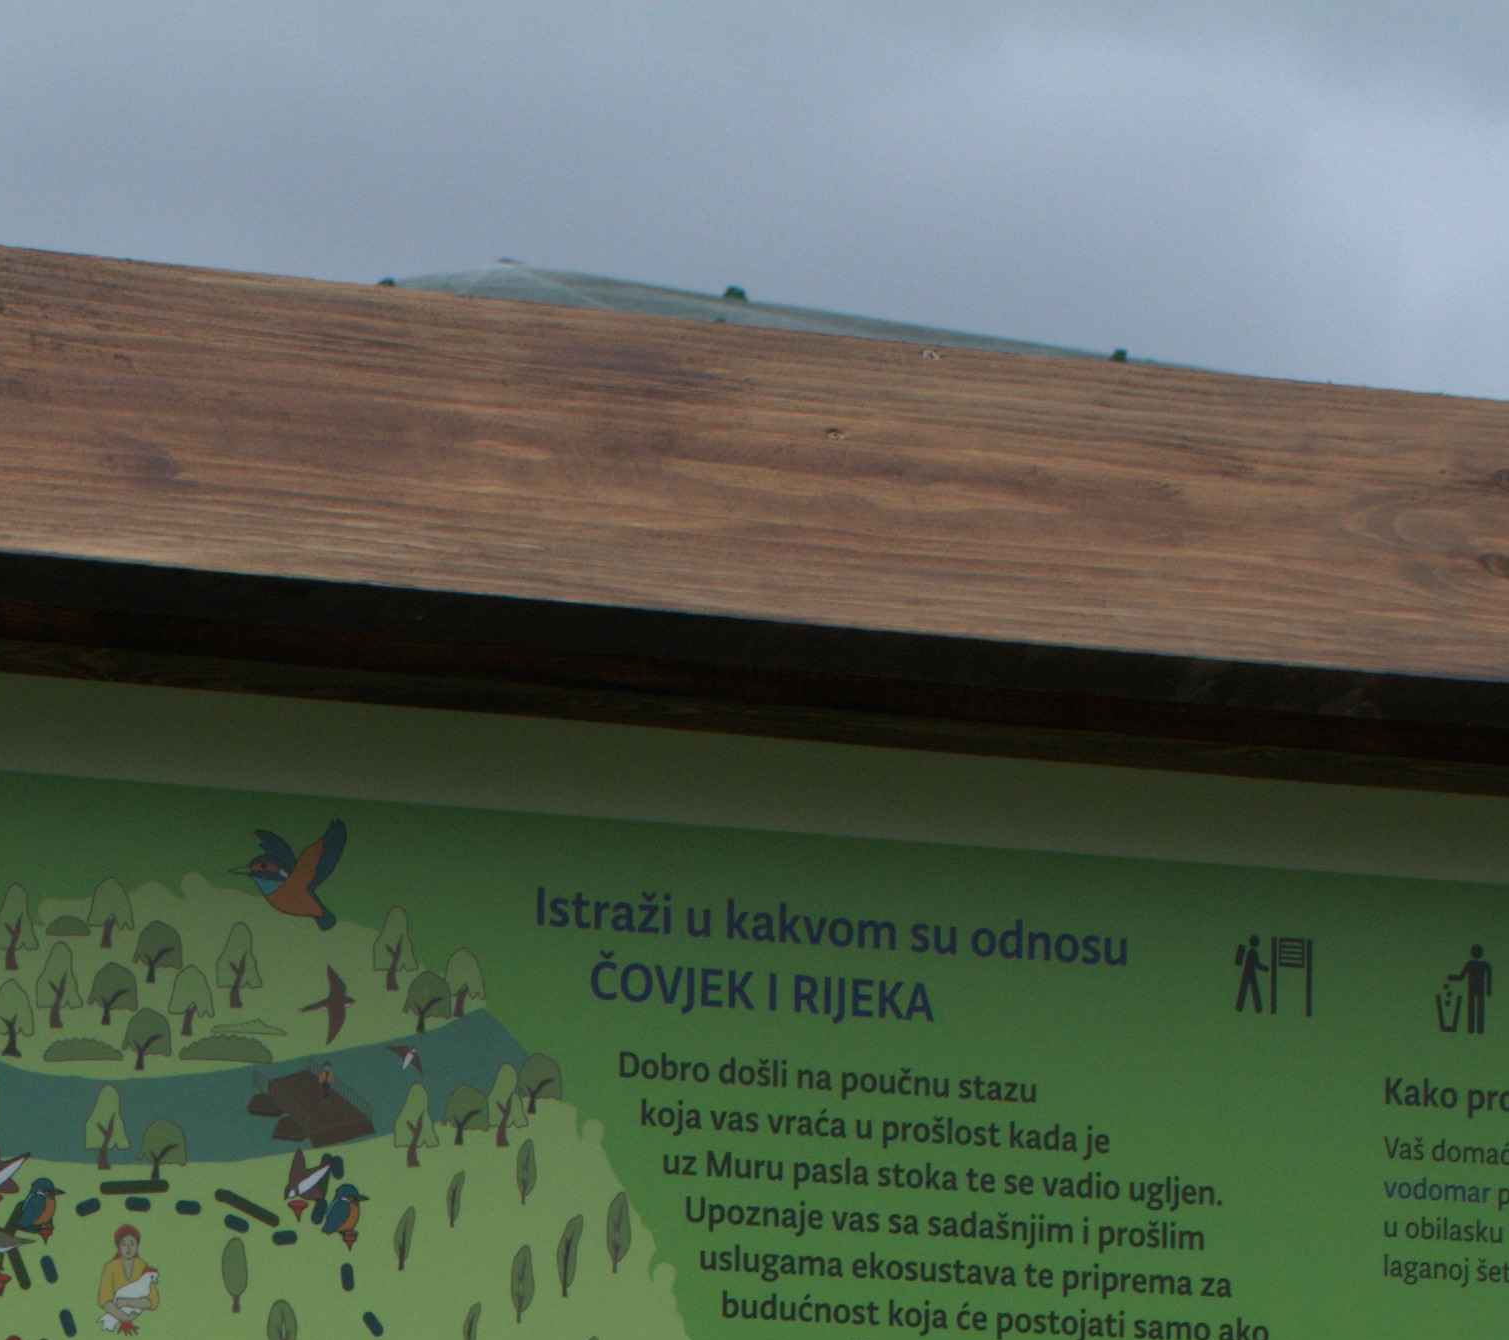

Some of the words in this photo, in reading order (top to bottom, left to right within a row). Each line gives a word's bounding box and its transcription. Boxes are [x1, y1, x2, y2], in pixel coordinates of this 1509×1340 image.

[536, 885, 672, 935] Istraži
[686, 906, 712, 937] u
[726, 897, 897, 950] kakvom
[910, 922, 958, 956] su
[970, 918, 1128, 967] odnosu
[590, 949, 755, 1015] ČOVJEK
[768, 972, 777, 1012] I
[793, 973, 935, 1024] RIJEKA
[618, 1049, 711, 1084] Dobro
[718, 1056, 788, 1088] došli
[796, 1068, 833, 1091] na
[840, 1067, 950, 1101] poučnu
[958, 1074, 1037, 1104] stazu
[1384, 1076, 1459, 1110] Kako
[1382, 1135, 1425, 1161] Vaš
[1383, 1176, 1491, 1204] vodomar
[684, 1195, 824, 1237] Upoznaje
[831, 1210, 881, 1233] vas
[887, 1212, 919, 1236] sa
[927, 1210, 1074, 1250] sadašnjim
[1082, 1216, 1090, 1246] i
[1098, 1220, 1205, 1254] prošlim
[1383, 1219, 1398, 1239] u
[1404, 1215, 1504, 1244] obilasku
[699, 1243, 844, 1282] uslugama
[851, 1250, 1017, 1287] ekosustava
[1024, 1262, 1054, 1289] te
[1061, 1262, 1193, 1300] priprema
[1200, 1275, 1233, 1298] za
[1382, 1253, 1470, 1288] laganoj
